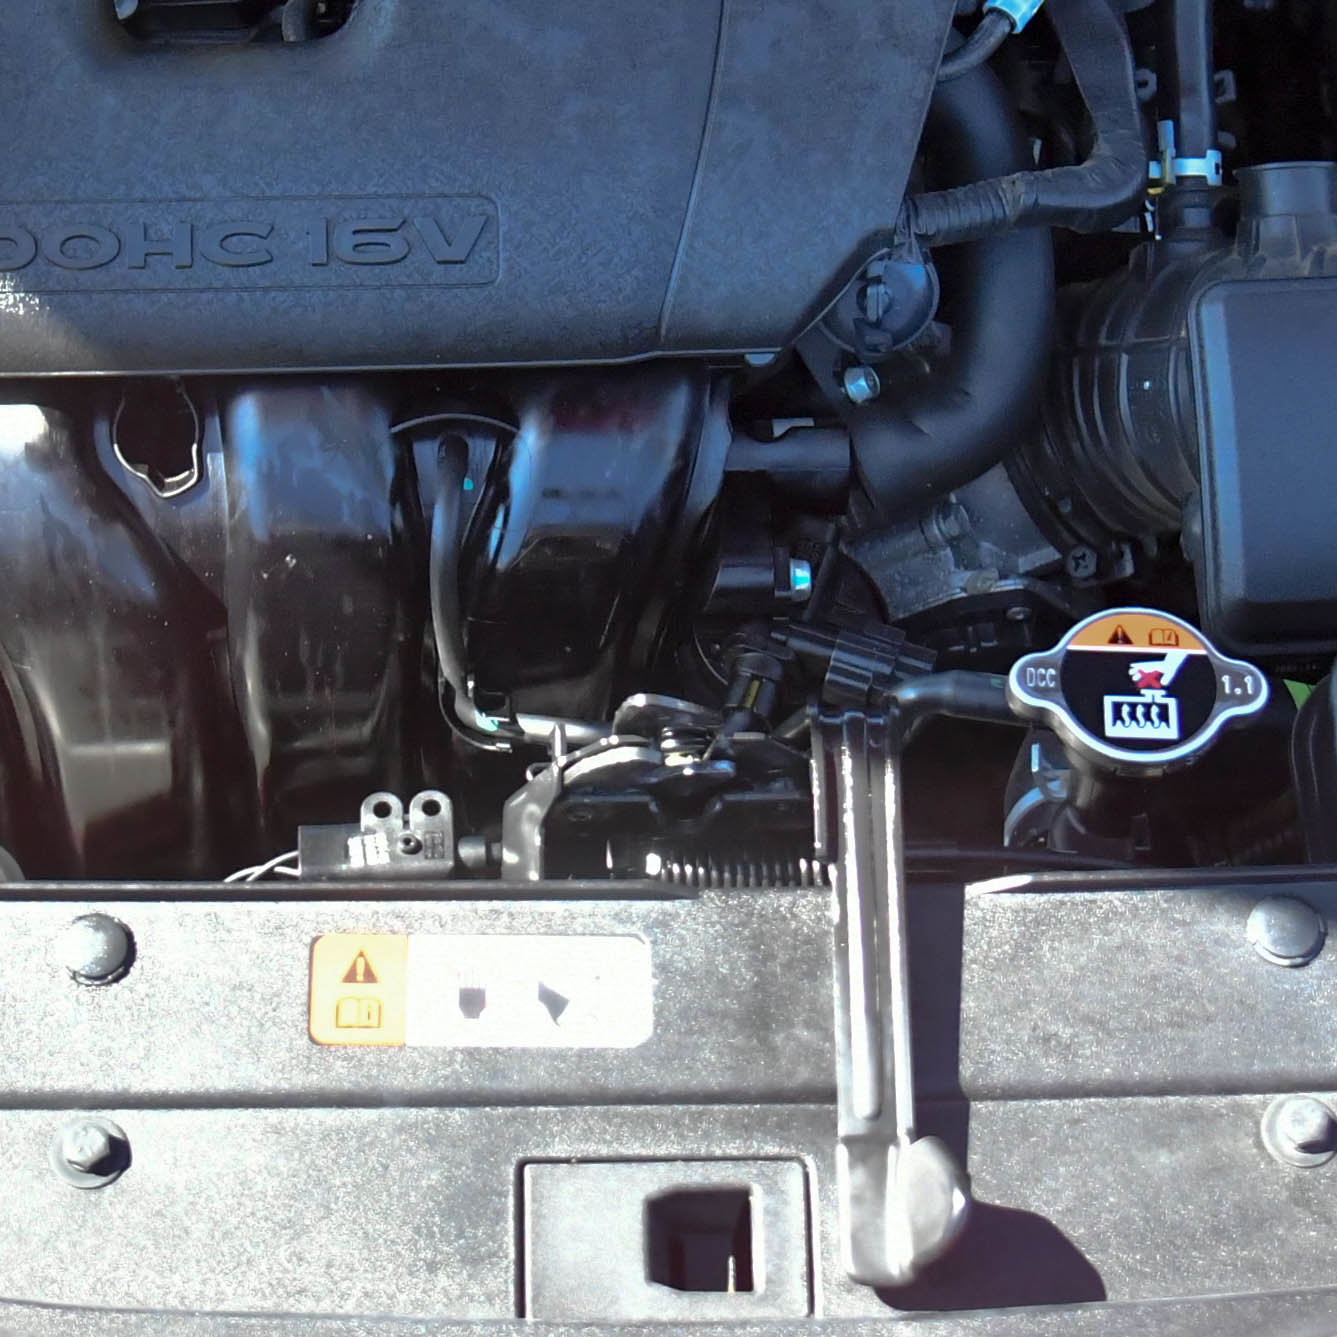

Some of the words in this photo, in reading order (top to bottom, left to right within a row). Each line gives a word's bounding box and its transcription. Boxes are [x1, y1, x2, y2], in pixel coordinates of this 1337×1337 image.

[302, 214, 491, 266] 16V
[1025, 667, 1057, 688] DCC
[1220, 674, 1257, 695] 1.1
